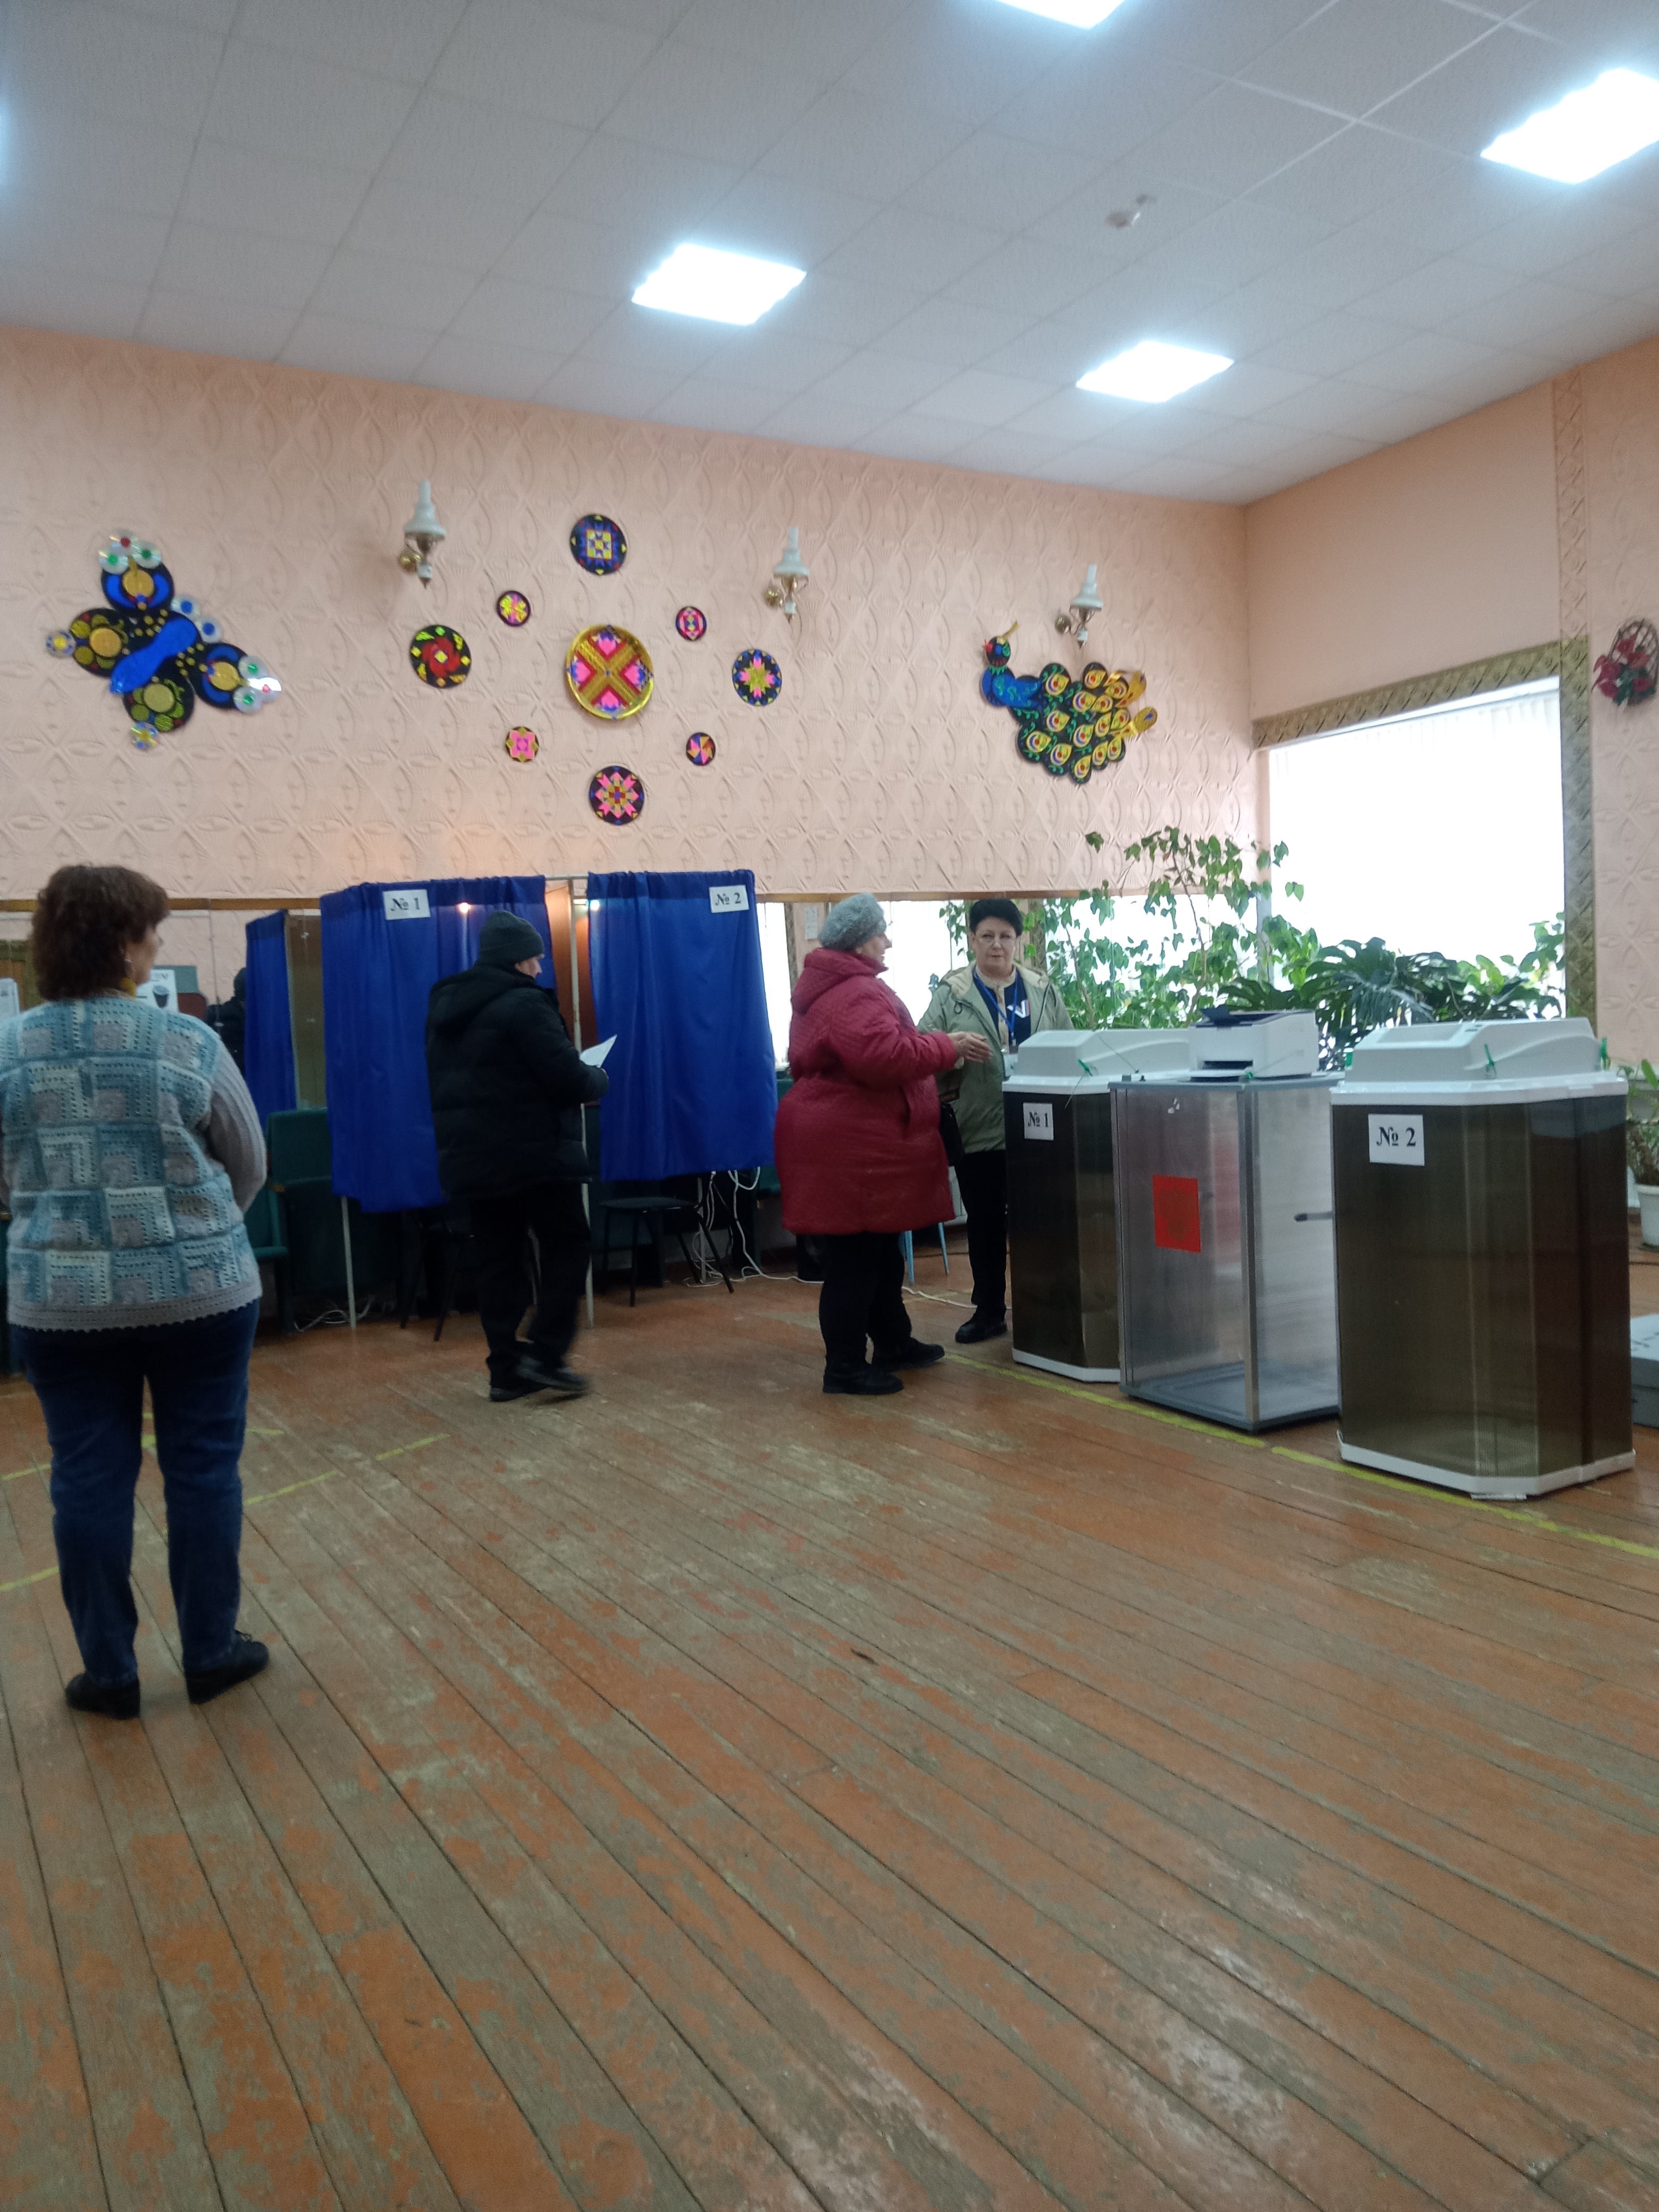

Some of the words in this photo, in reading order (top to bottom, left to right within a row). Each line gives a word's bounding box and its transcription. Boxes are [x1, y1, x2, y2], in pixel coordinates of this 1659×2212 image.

[390, 898, 409, 911] №
[414, 897, 420, 910] 1
[715, 893, 730, 906] №
[734, 892, 741, 904] 2
[1027, 1112, 1040, 1127] №
[1044, 1112, 1049, 1127] 1
[1376, 1126, 1399, 1146] №
[1405, 1127, 1416, 1147] 2
